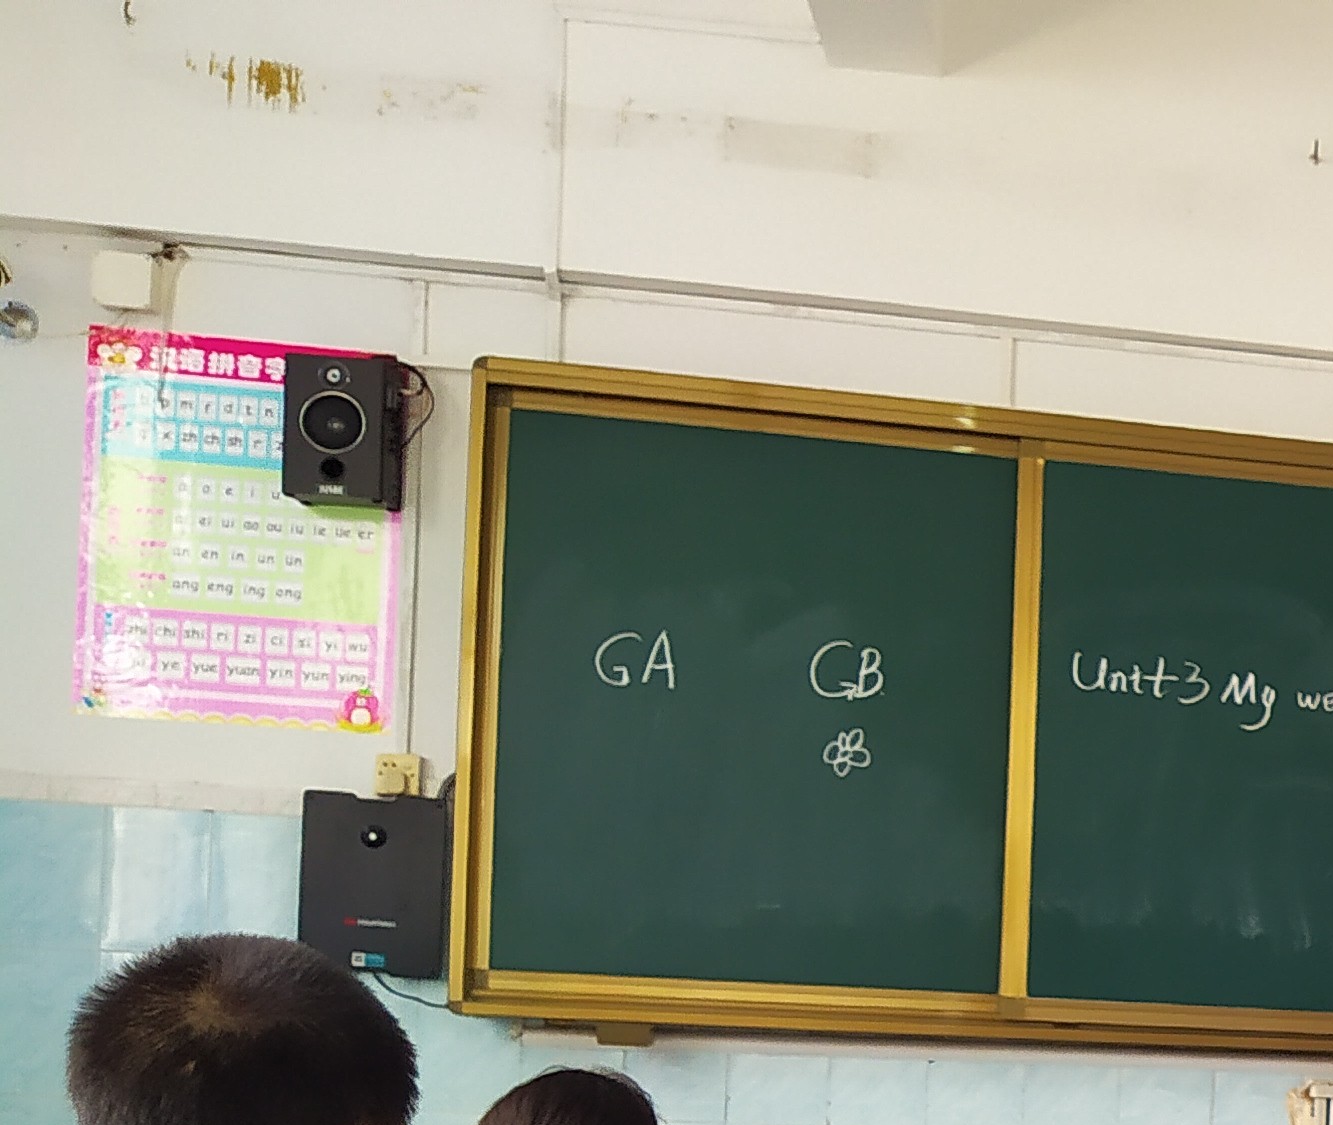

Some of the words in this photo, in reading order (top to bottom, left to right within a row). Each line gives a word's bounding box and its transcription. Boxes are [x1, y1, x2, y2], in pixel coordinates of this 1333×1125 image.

[207, 581, 233, 597] eng
[161, 660, 180, 673] ye
[269, 667, 293, 680] yin
[338, 673, 367, 686] ying
[594, 630, 675, 690] GA
[809, 639, 884, 701] GB
[1219, 671, 1277, 732] My
